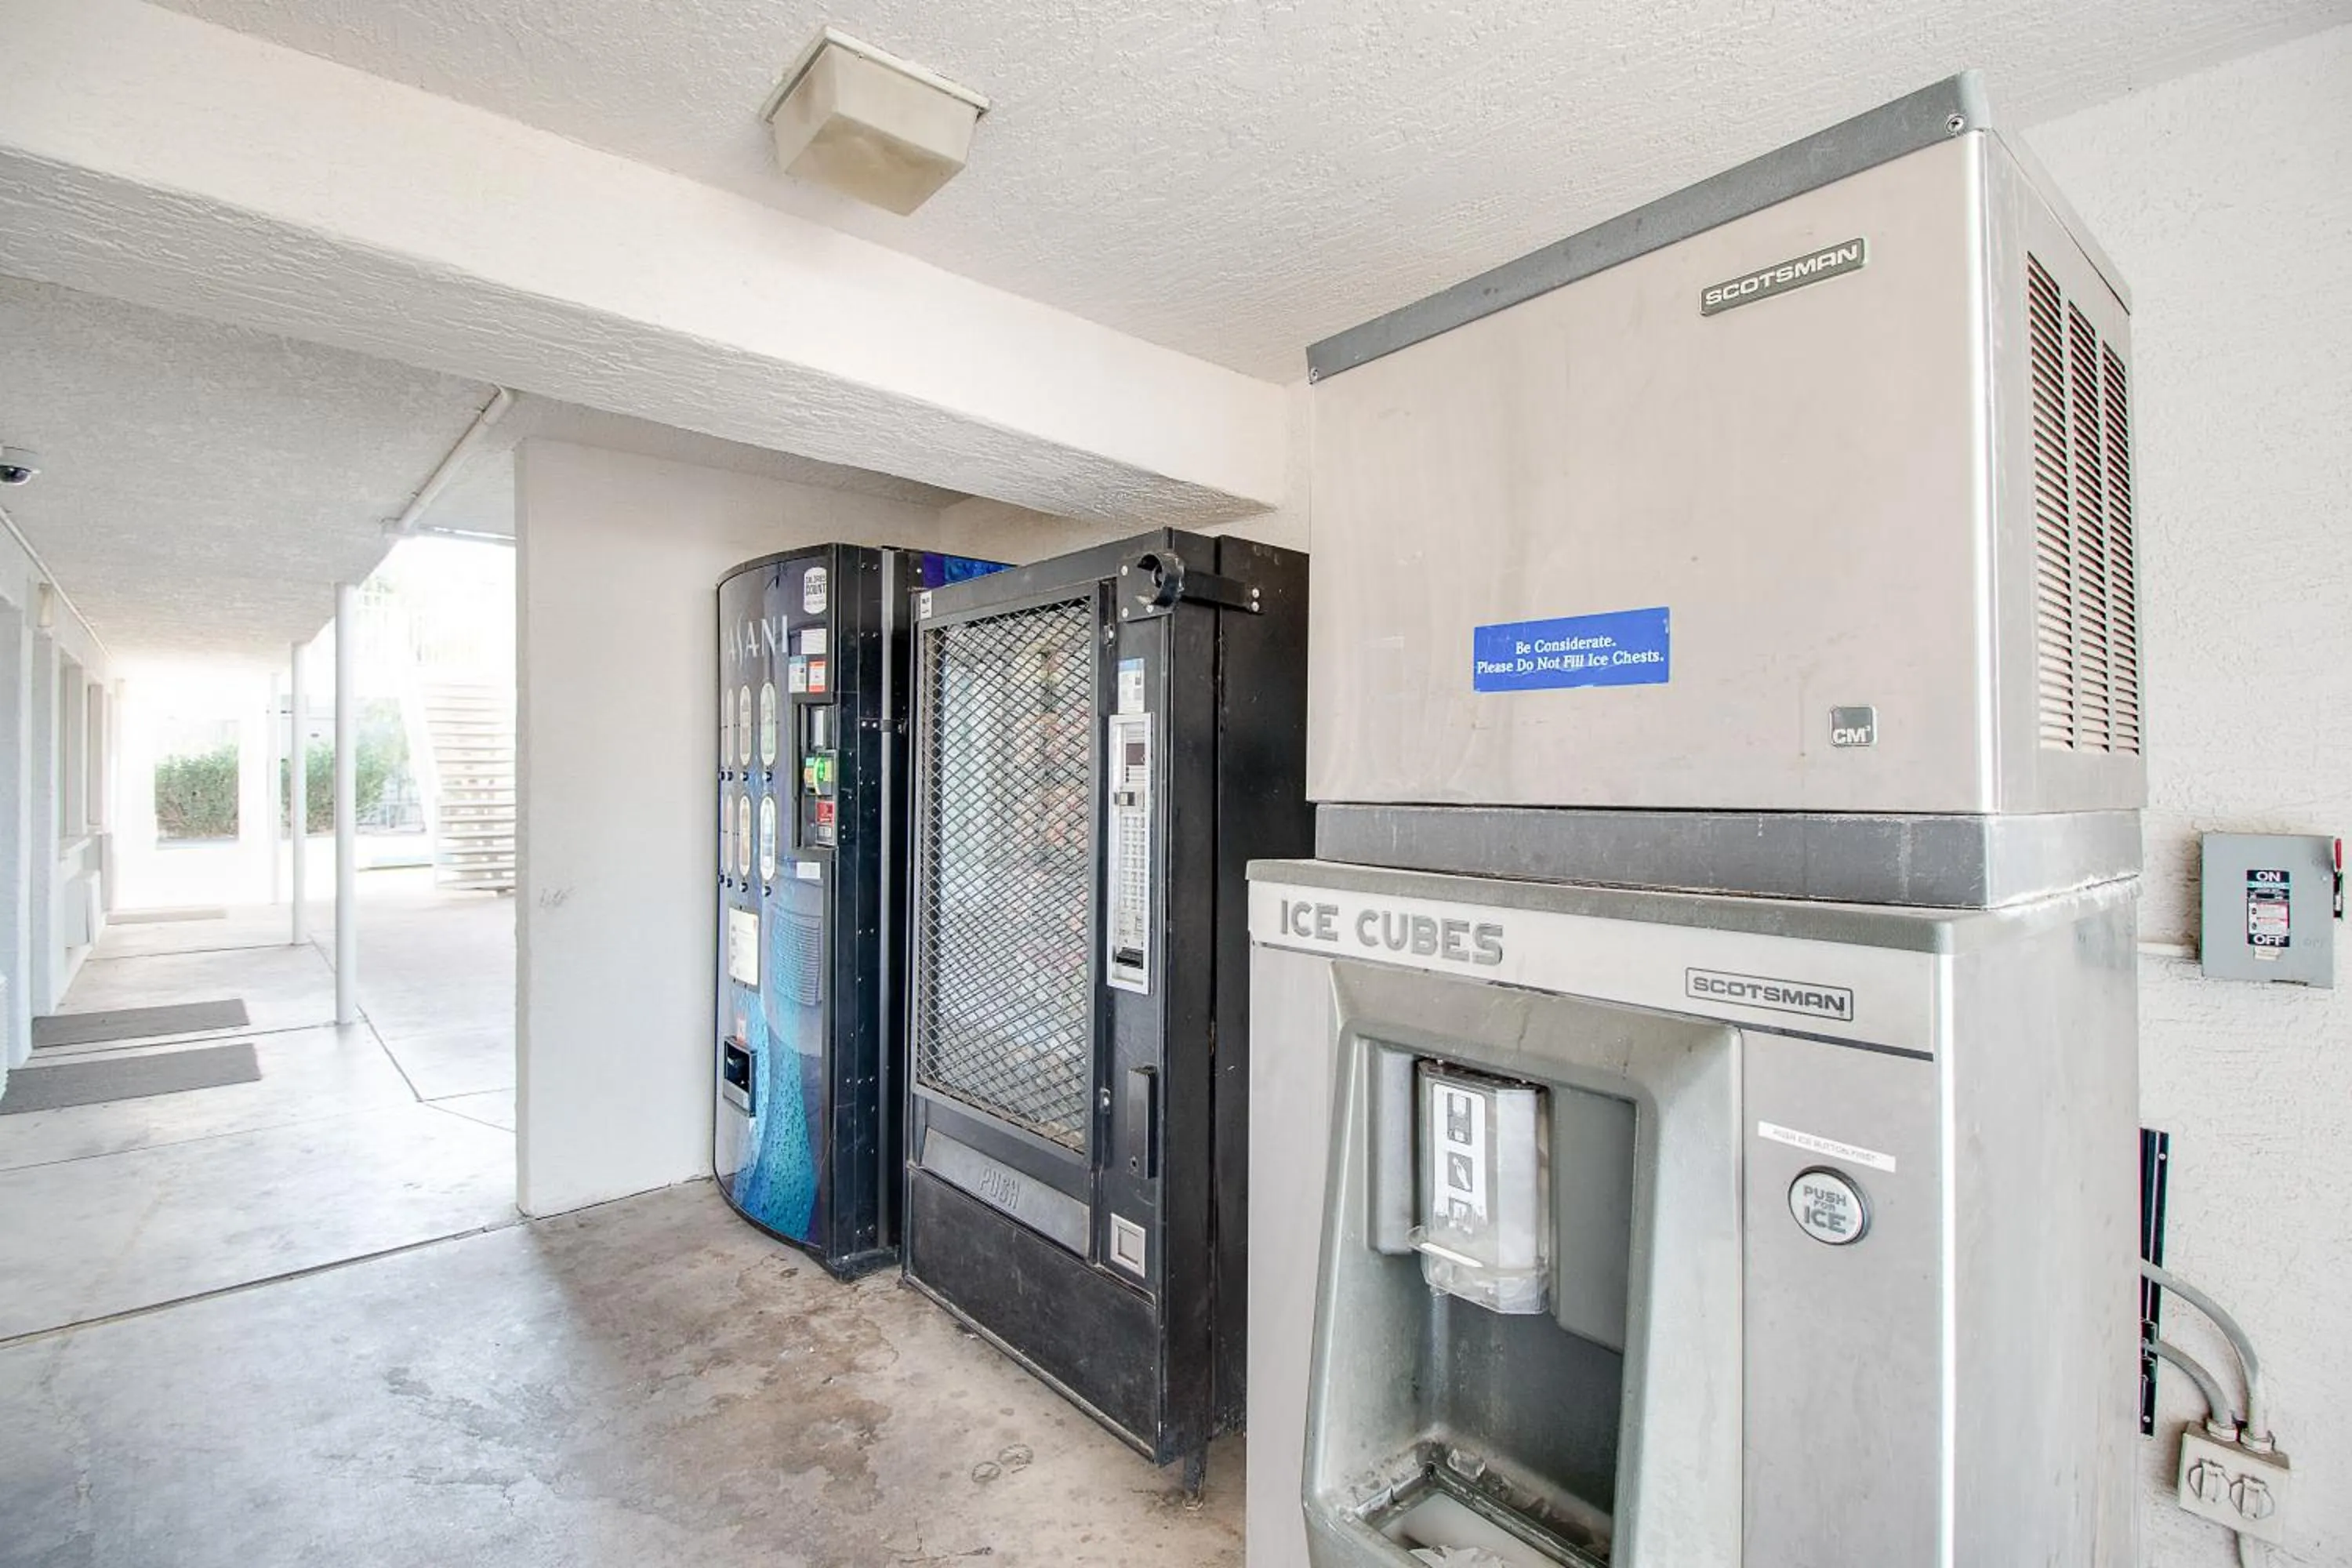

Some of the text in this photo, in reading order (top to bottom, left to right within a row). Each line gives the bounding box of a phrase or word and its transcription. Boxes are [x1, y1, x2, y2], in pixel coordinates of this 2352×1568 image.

[1705, 244, 1857, 305] SCOTSMAN
[1515, 636, 1617, 655] Be Considerate.
[1477, 649, 1664, 674] Please Do Not Fill Ice Chests.
[2256, 871, 2281, 882] ON
[1280, 899, 1504, 966] ICE CUBES
[2253, 934, 2285, 946] OFF
[1693, 977, 1845, 1012] SCOTSMAN
[980, 1166, 1020, 1209] PUSH
[1803, 1185, 1847, 1207] PUSH
[1813, 1200, 1835, 1211] FOR
[1804, 1206, 1847, 1235] ICE
